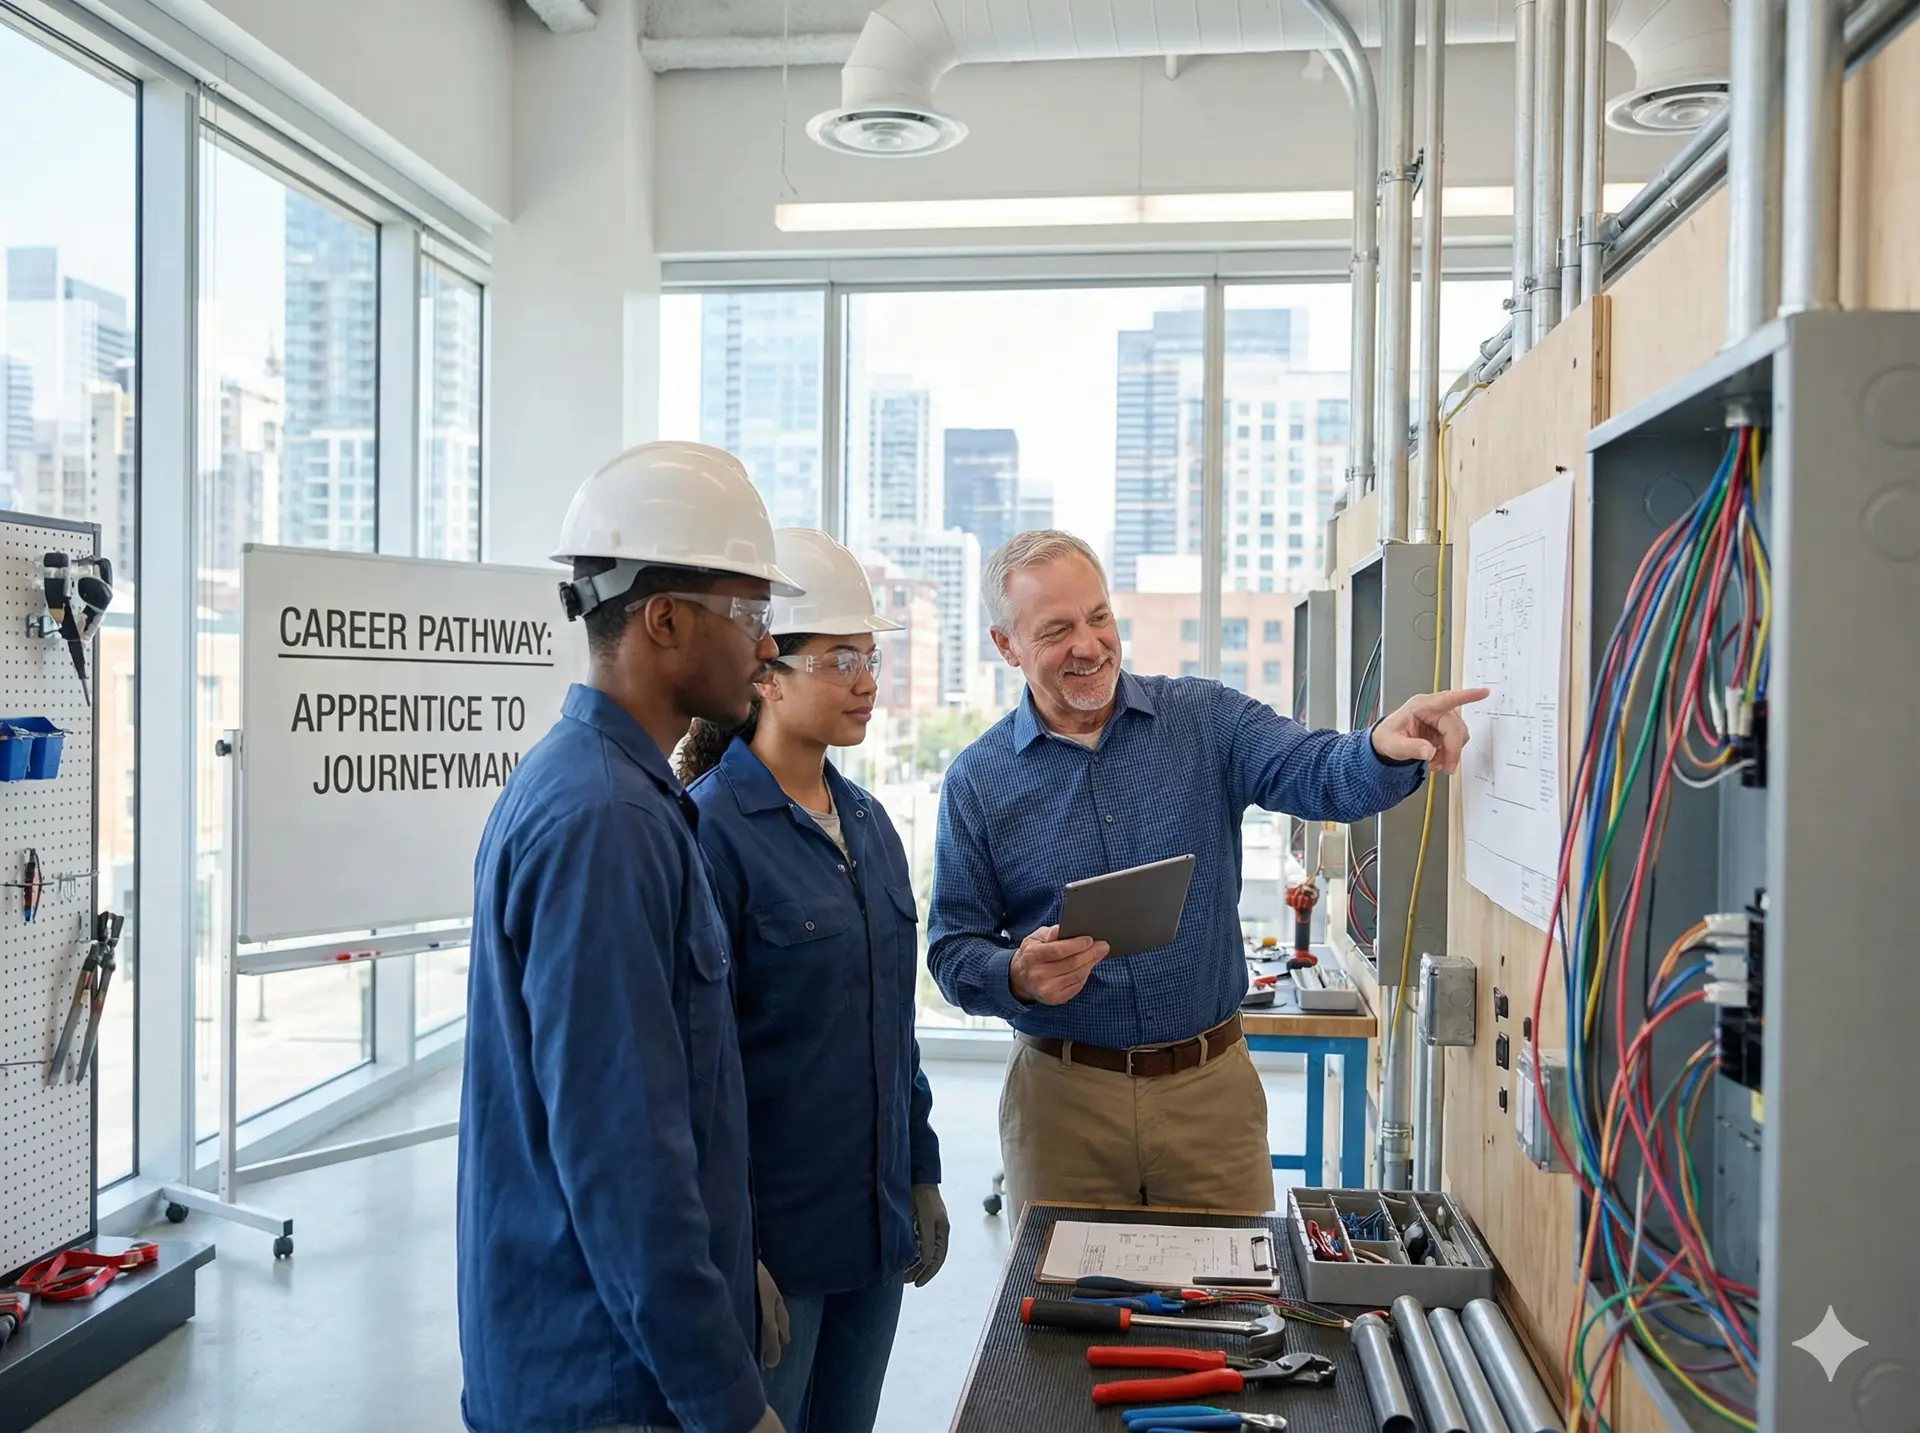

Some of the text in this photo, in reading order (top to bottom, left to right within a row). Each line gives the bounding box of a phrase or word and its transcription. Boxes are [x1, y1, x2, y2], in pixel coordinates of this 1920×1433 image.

[280, 606, 552, 656] CAREER PATHWAY:
[291, 693, 526, 733] APPRENTICE TO
[313, 752, 519, 795] JOURNEYMAN
